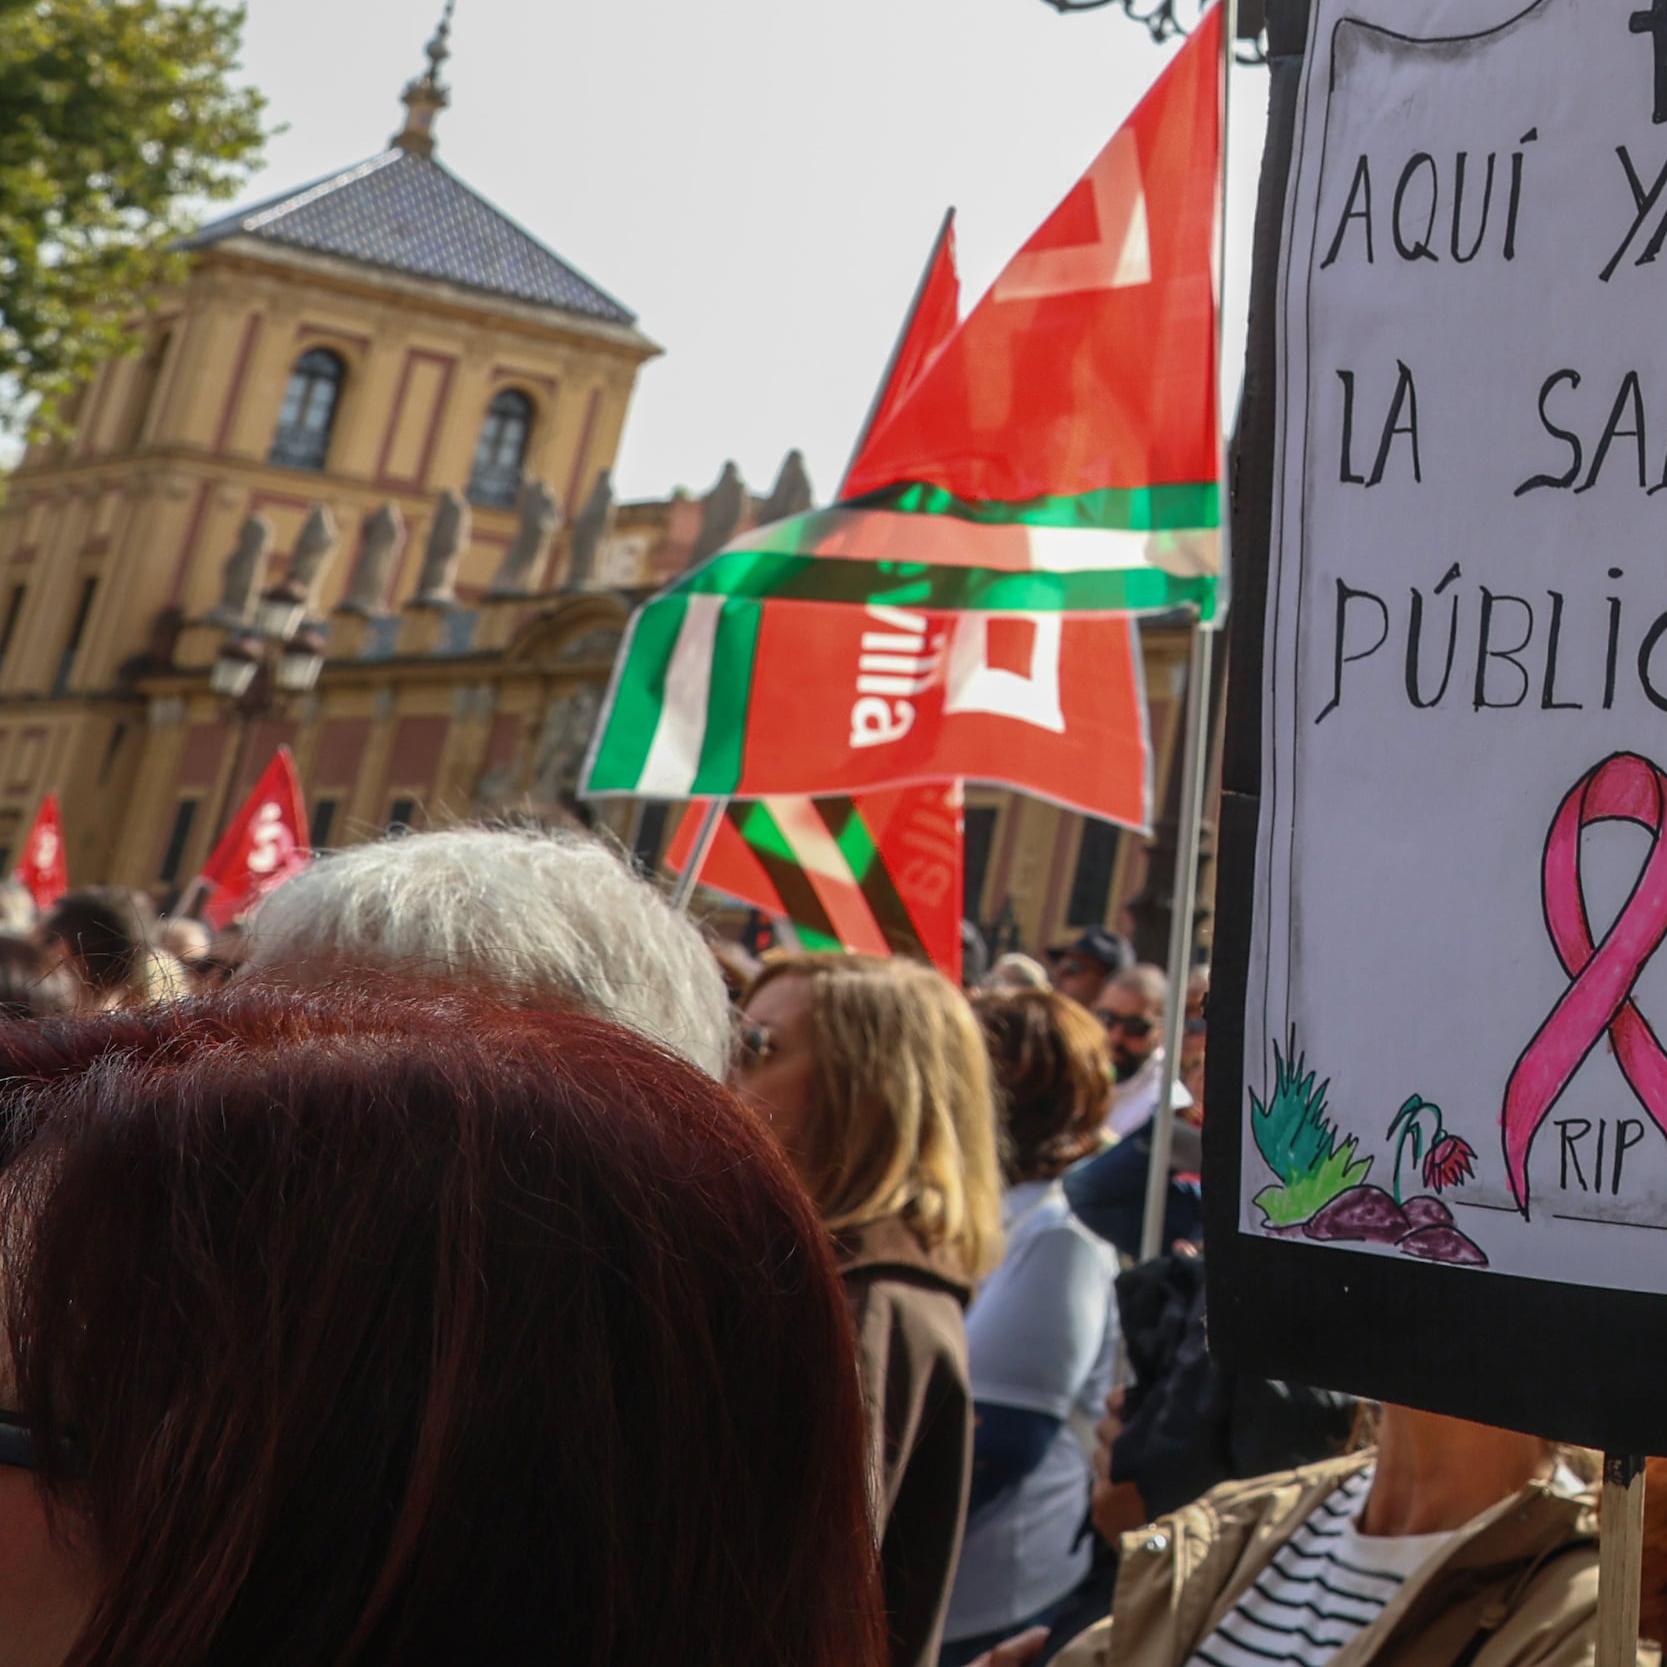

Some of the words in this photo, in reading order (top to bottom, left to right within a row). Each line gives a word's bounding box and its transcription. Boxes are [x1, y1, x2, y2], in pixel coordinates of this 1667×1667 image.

[1319, 126, 1540, 272] AQUÍ
[1335, 358, 1423, 490] LA
[1551, 1116, 1647, 1195] RIP
